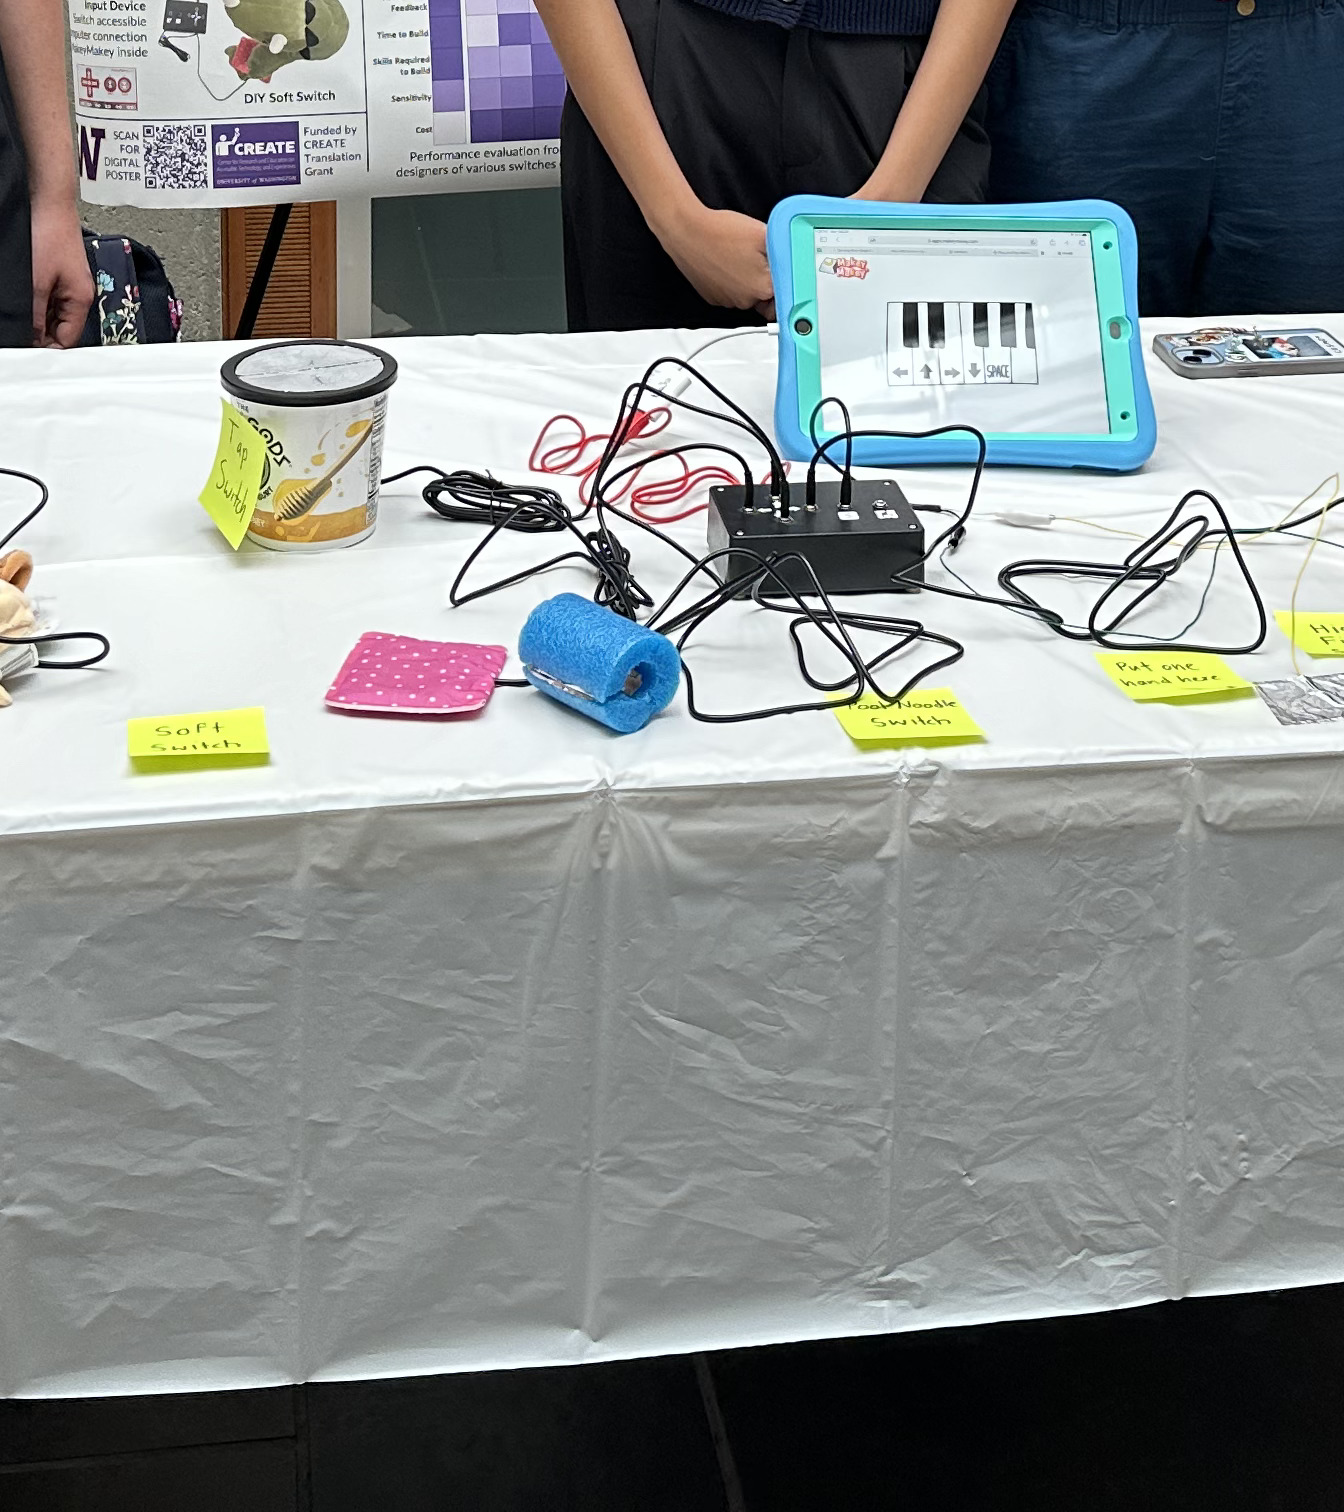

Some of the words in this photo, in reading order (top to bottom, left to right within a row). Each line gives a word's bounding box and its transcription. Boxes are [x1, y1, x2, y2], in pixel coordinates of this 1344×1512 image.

[85, 0, 107, 11] Input
[110, 0, 146, 11] Device
[244, 92, 266, 104] DIY
[269, 92, 293, 102] Soft
[296, 91, 336, 101] Switch
[113, 131, 139, 140] SCAN
[304, 126, 342, 136] Funded
[345, 125, 357, 136] by
[235, 141, 295, 155] CREATE
[304, 139, 346, 149] CREATE
[120, 145, 140, 154] FOR
[410, 150, 481, 162] Performance
[484, 146, 540, 158] evaluation
[105, 158, 141, 167] DIGITAL
[305, 153, 361, 162] Translation
[305, 167, 333, 176] Grant
[396, 166, 448, 178] designers
[452, 164, 464, 174] of
[466, 164, 505, 174] various
[508, 161, 556, 172] switches
[106, 171, 141, 181] POSTER
[986, 363, 1011, 380] SPACE
[1116, 662, 1153, 671] Put
[1162, 663, 1199, 671] one
[1120, 677, 1172, 687] hand
[898, 699, 957, 709] Noodle
[871, 716, 951, 727] Switch
[155, 722, 224, 736] Soft
[151, 740, 241, 751] Switch
